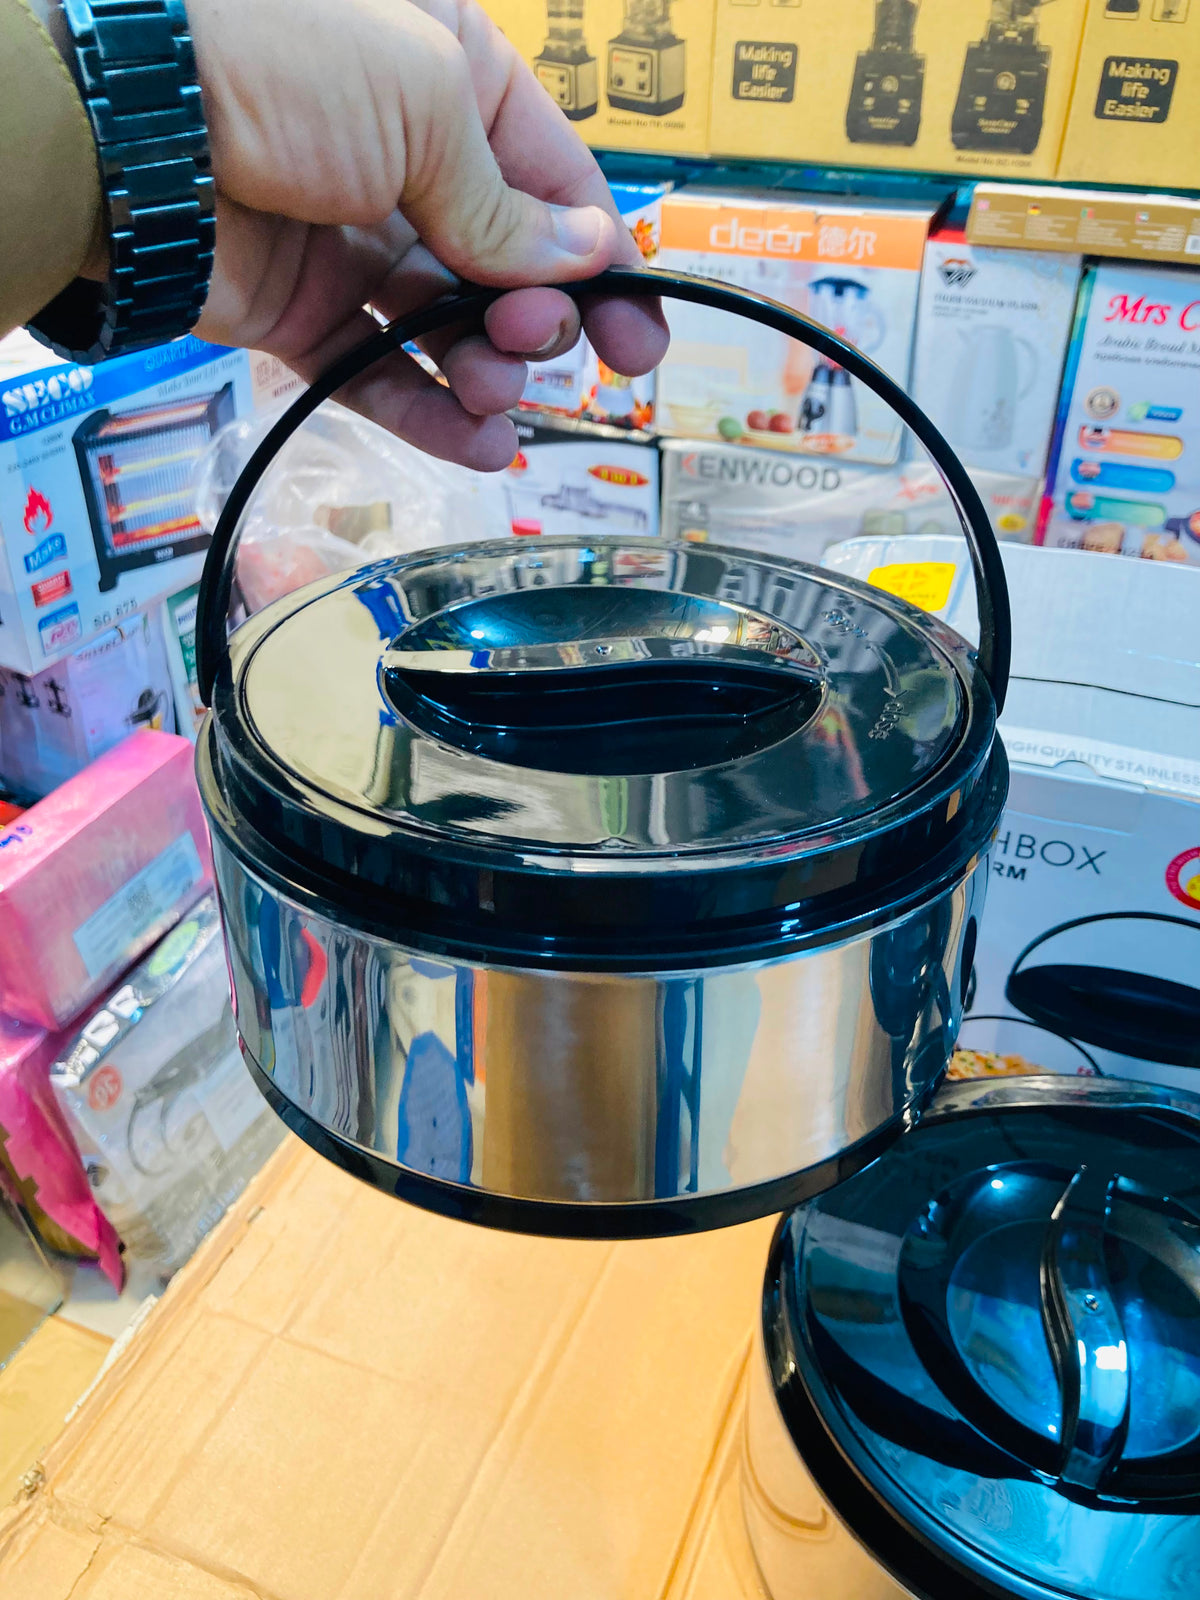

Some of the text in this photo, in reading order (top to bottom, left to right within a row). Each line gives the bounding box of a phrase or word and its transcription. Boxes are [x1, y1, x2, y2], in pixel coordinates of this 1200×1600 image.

[740, 45, 793, 68] Making
[752, 67, 778, 81] life
[1108, 61, 1171, 86] Making
[739, 81, 788, 99] Easier
[1120, 81, 1150, 99] life
[1104, 100, 1160, 118] Easier
[1104, 293, 1172, 326] Mrs
[2, 366, 94, 418] SECO
[676, 452, 841, 492] KENWOOD
[1006, 740, 1038, 753] IGH
[1040, 745, 1112, 769] QUALITY
